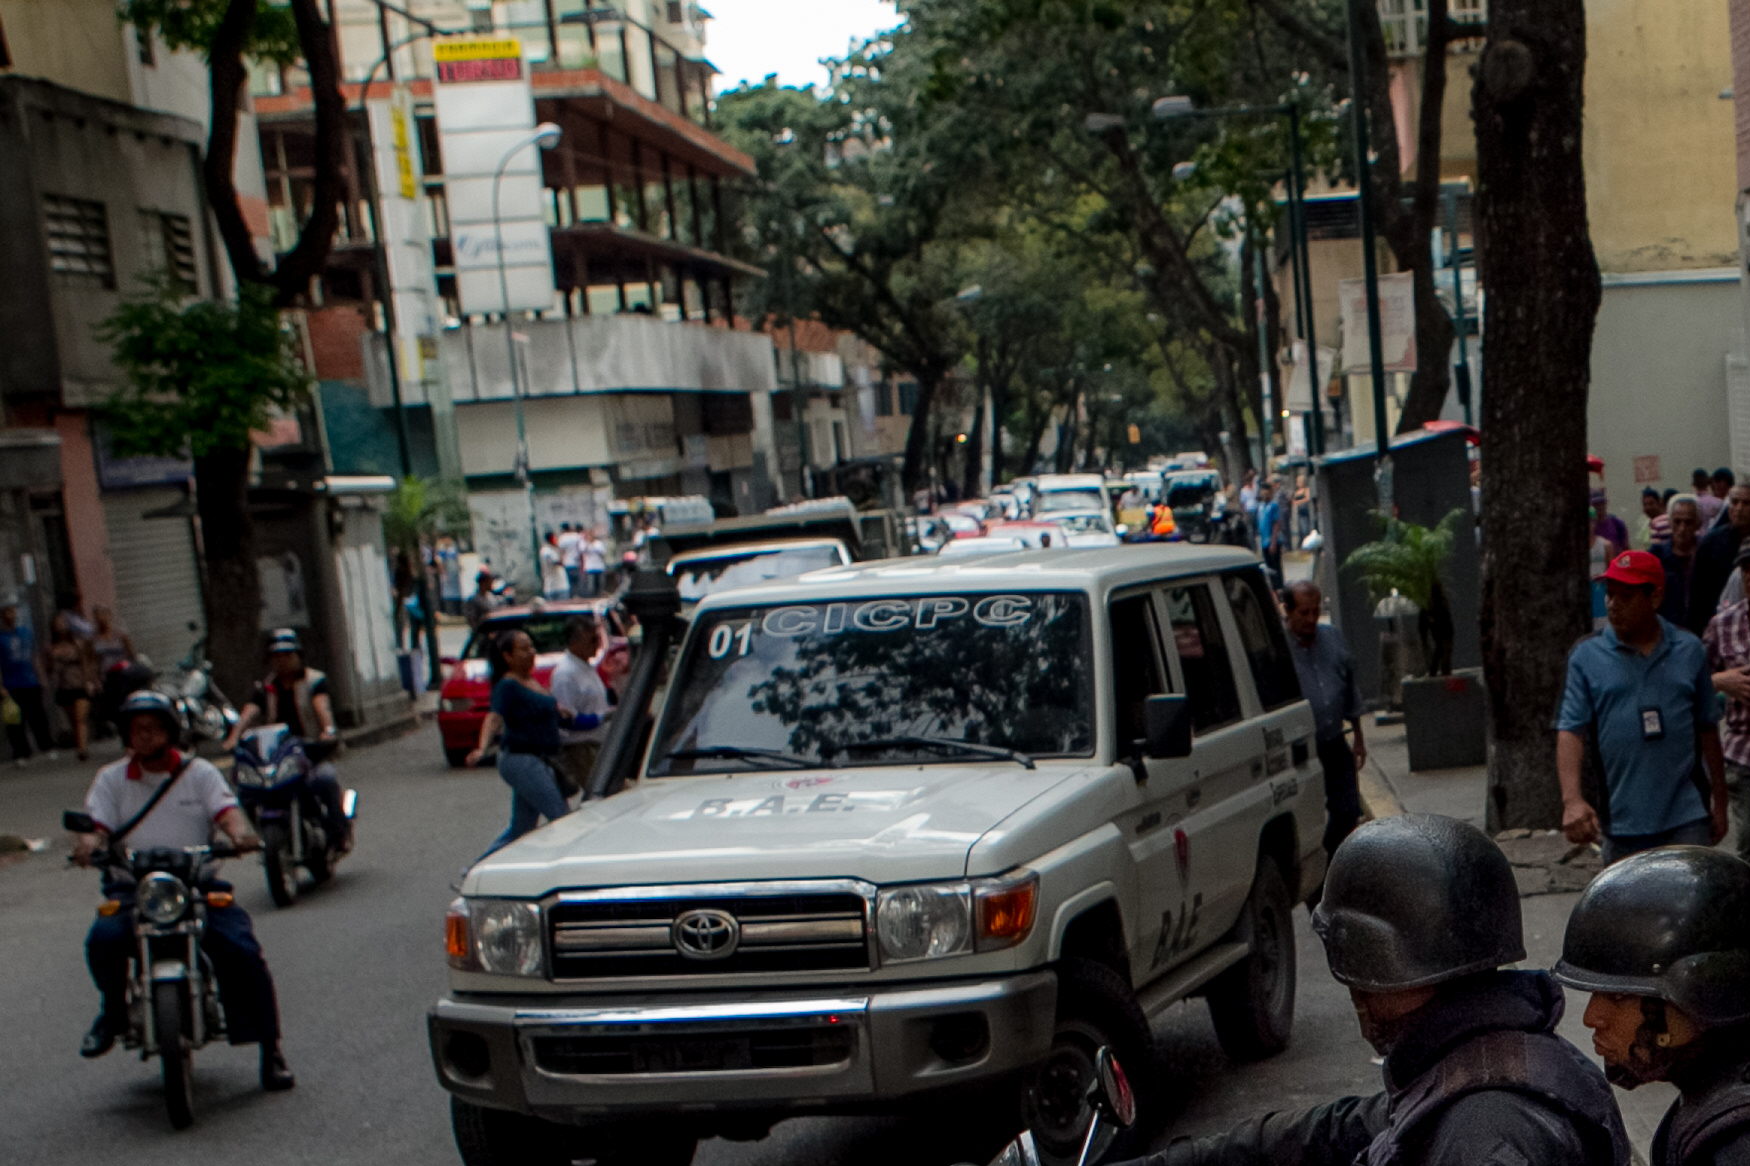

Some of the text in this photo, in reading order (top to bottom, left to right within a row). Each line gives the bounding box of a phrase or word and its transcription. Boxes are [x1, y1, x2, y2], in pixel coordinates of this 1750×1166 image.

[708, 595, 1032, 659] 01 CICPC
[690, 793, 856, 819] B.A.E.
